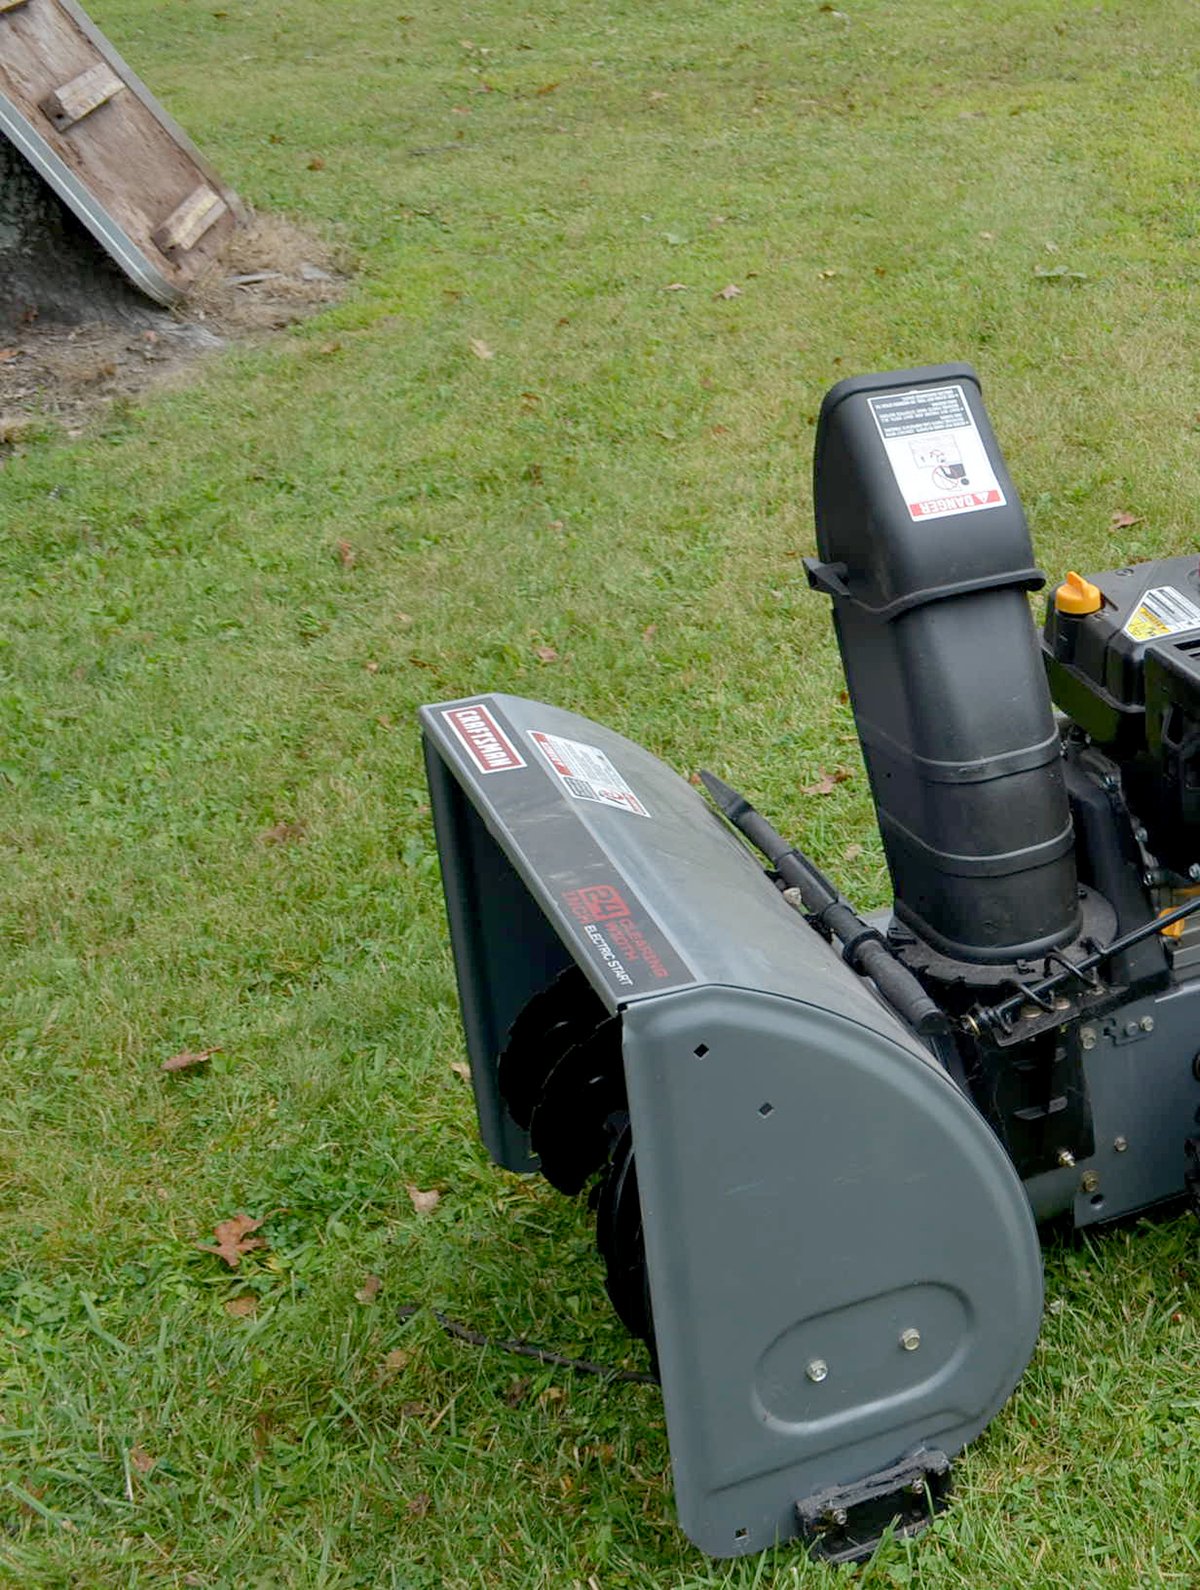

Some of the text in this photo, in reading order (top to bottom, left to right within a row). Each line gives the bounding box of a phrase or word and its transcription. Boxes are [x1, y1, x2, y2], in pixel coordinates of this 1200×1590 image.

[920, 494, 975, 513] DANGER
[455, 710, 512, 767] CRAFTSMAN
[584, 924, 633, 986] ELECTRIC START
